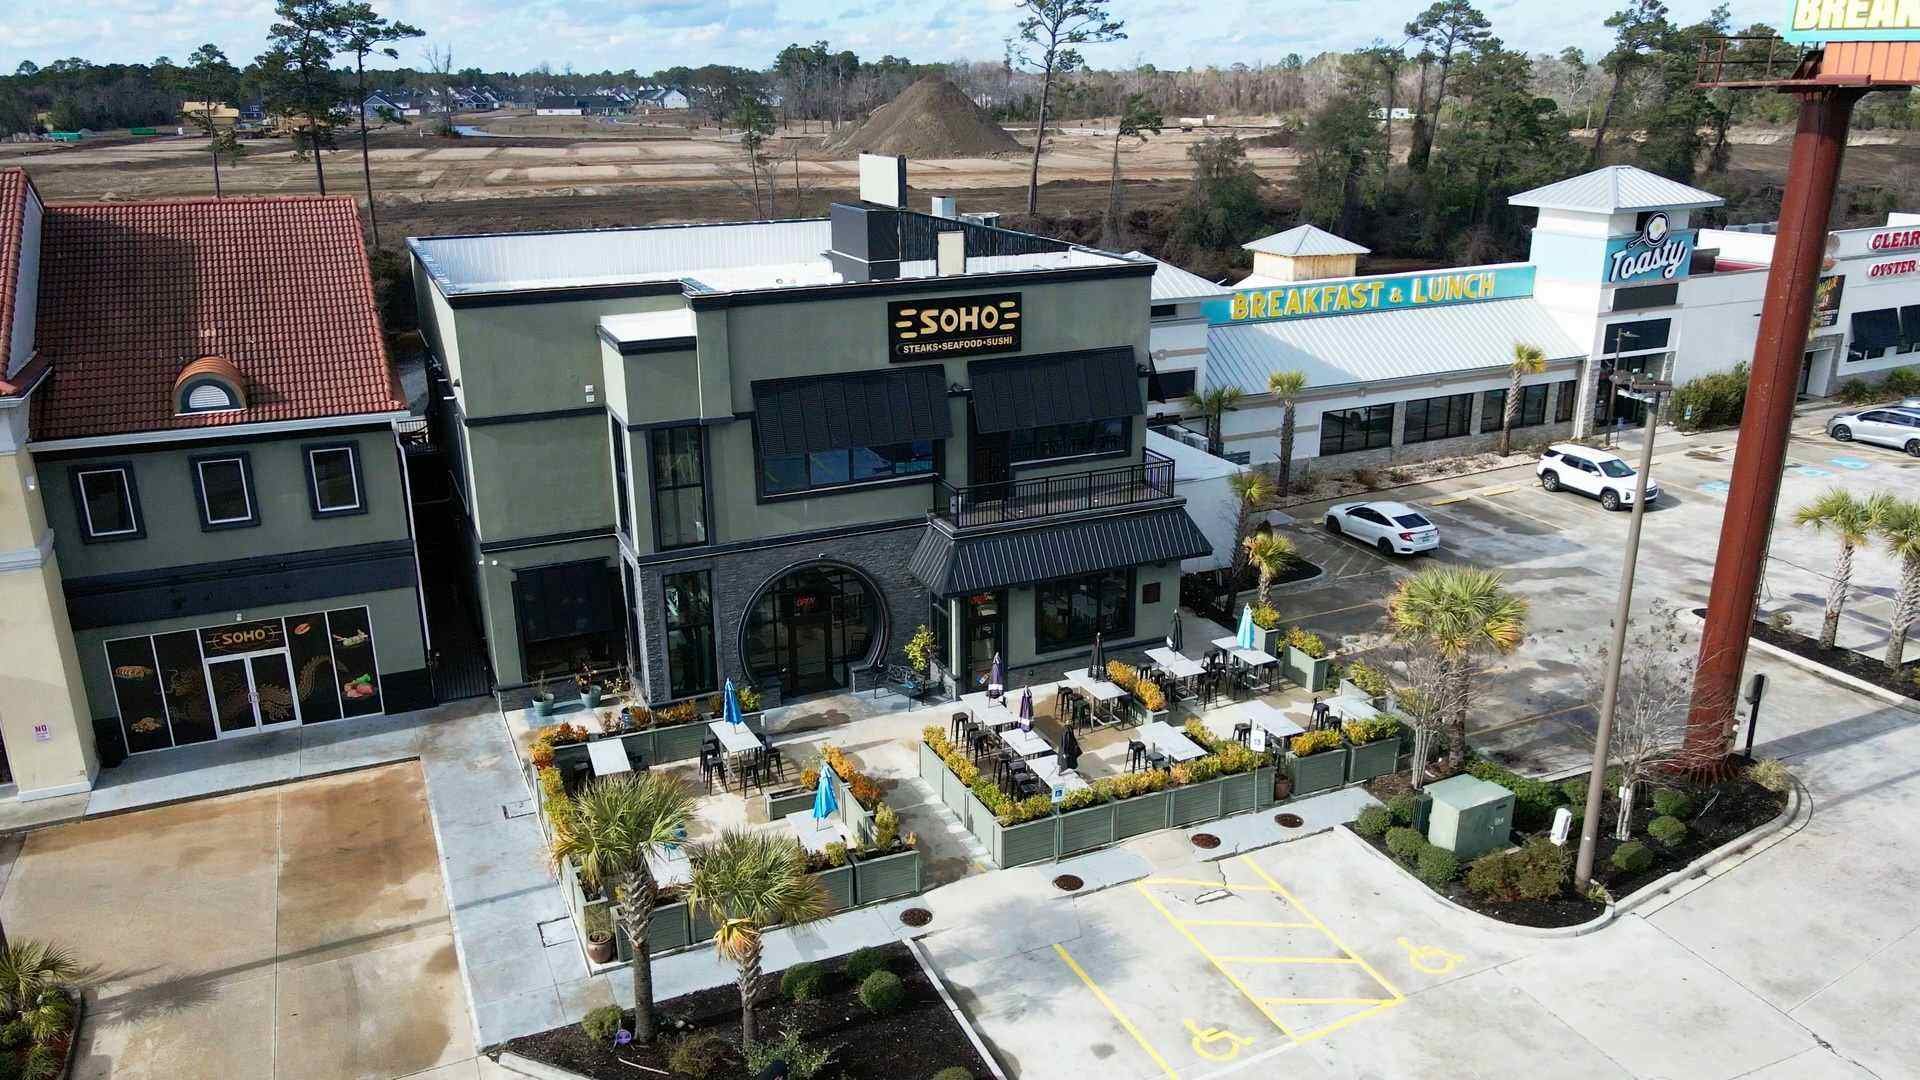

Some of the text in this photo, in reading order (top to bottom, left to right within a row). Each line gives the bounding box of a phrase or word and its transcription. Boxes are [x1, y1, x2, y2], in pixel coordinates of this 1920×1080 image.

[1609, 238, 1688, 283] Toasty
[1871, 259, 1916, 277] OYSTER
[1230, 272, 1496, 320] BREAKFAST & LUNCH
[920, 305, 999, 335] SOHO
[903, 336, 1013, 354] STEAKS SEAFOOD SUSHI
[222, 628, 266, 645] SOHO
